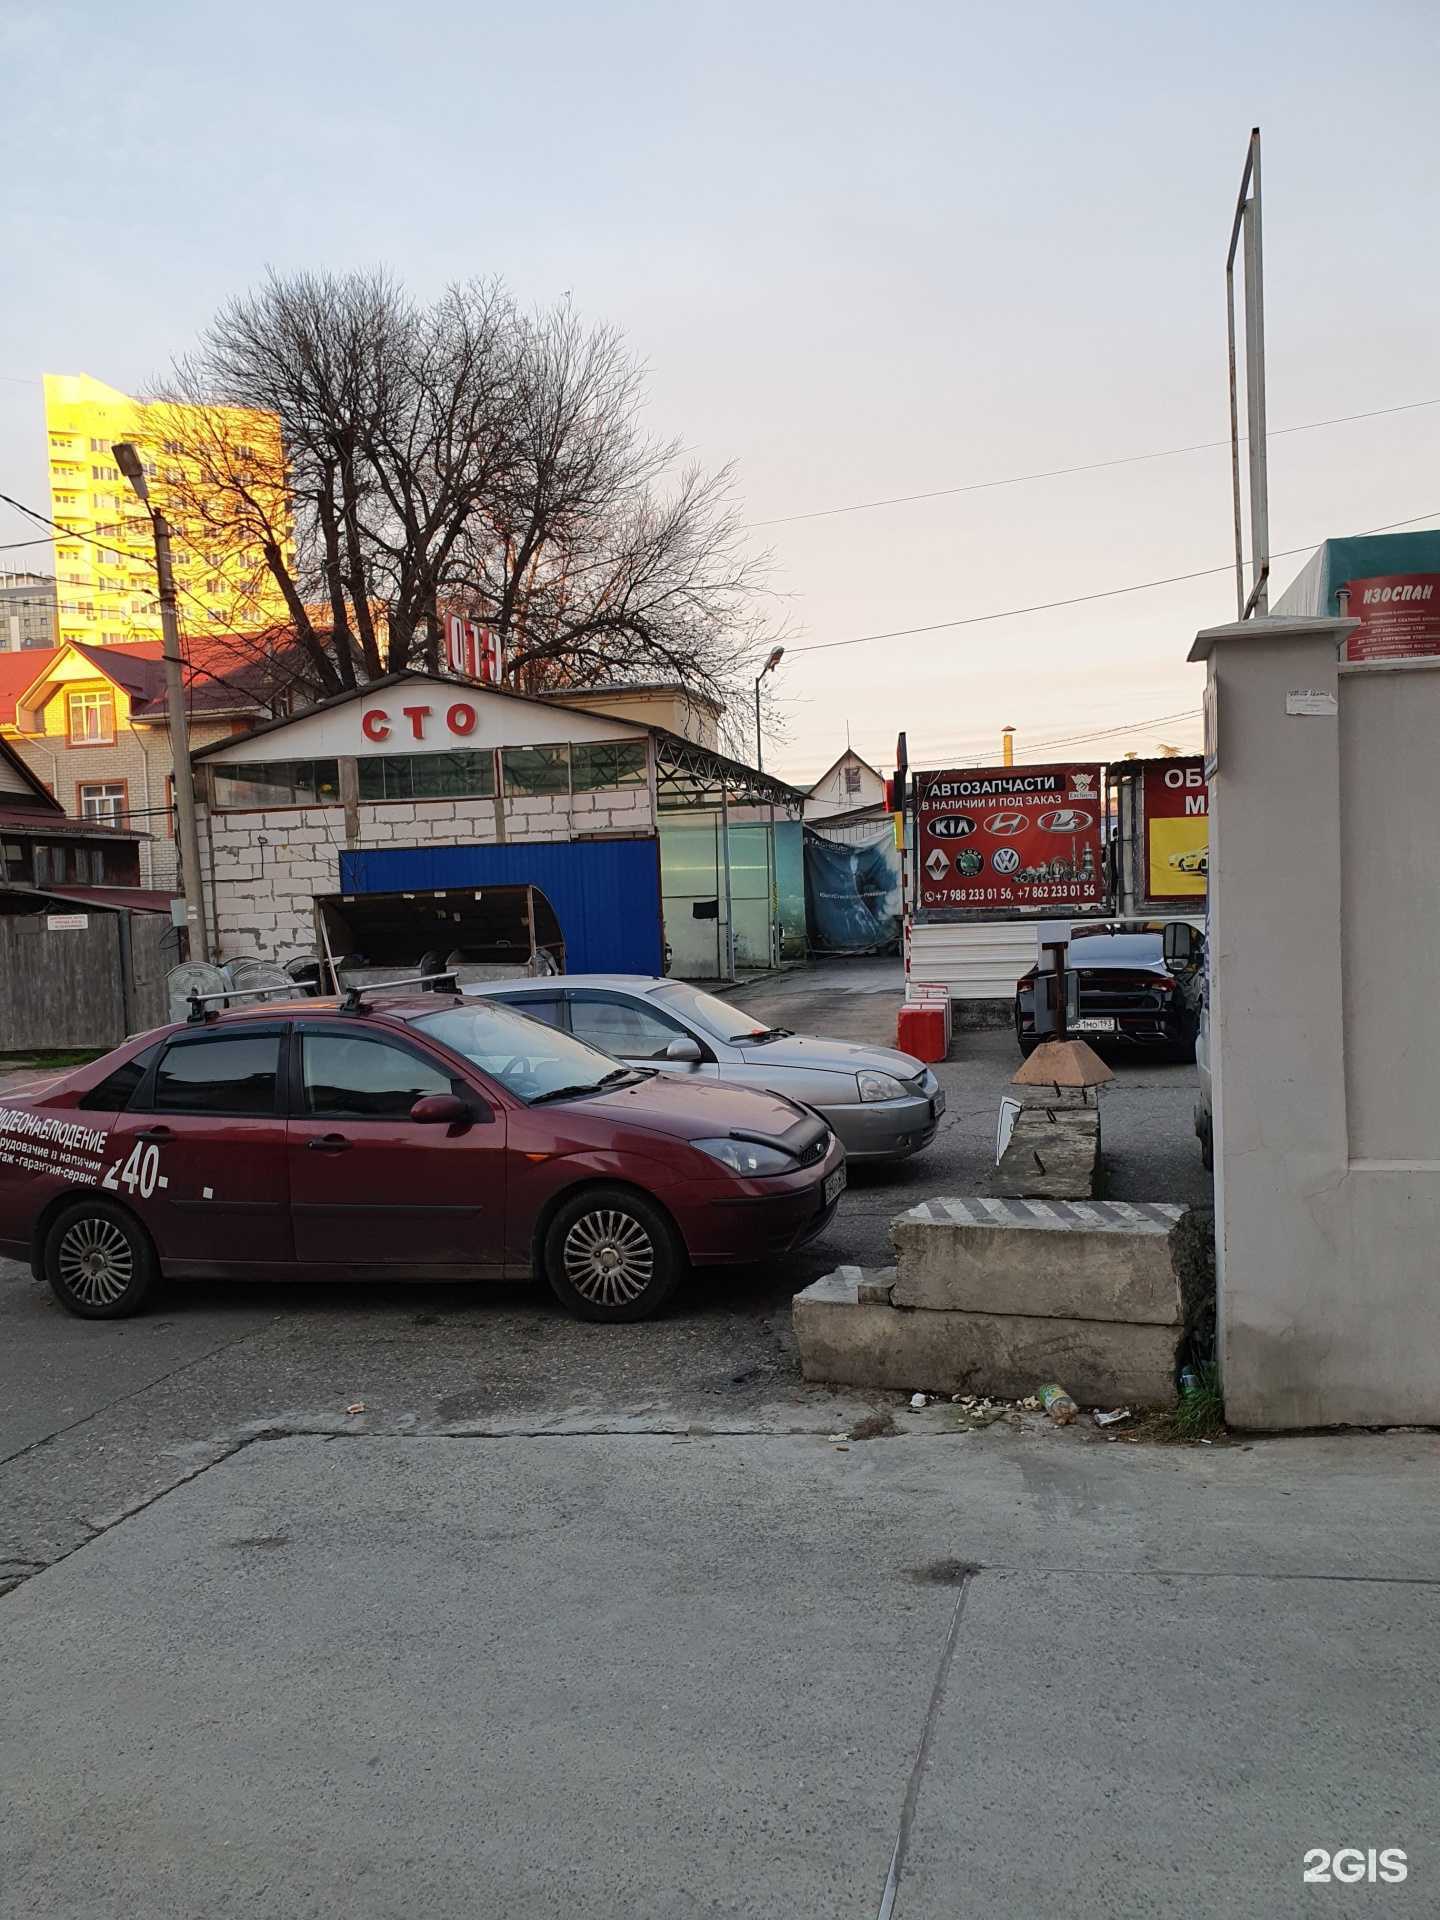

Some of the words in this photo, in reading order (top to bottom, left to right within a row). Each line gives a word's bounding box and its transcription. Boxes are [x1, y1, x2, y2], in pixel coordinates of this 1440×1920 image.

[1363, 585, 1434, 605] ИЗОСПАН
[362, 703, 478, 742] СТО
[930, 776, 1055, 797] АВТОЗАПЧАСТИ
[1164, 768, 1208, 789] ОБ
[922, 802, 929, 811] В
[932, 800, 986, 811] НАЛИЧИИ
[988, 798, 996, 808] И
[999, 797, 1023, 808] ПОД
[1026, 794, 1062, 806] ЗАКАЗ
[1185, 796, 1209, 815] М
[935, 820, 971, 835] KIA
[936, 890, 948, 901] +7
[950, 890, 966, 900] 988
[969, 889, 985, 900] 233
[987, 888, 997, 899] 01
[1000, 888, 1014, 900] 56,
[1017, 887, 1030, 898] +7
[1032, 886, 1048, 897] 862
[1051, 886, 1068, 897] 233
[1070, 885, 1080, 896] 01
[1083, 885, 1095, 896] 56
